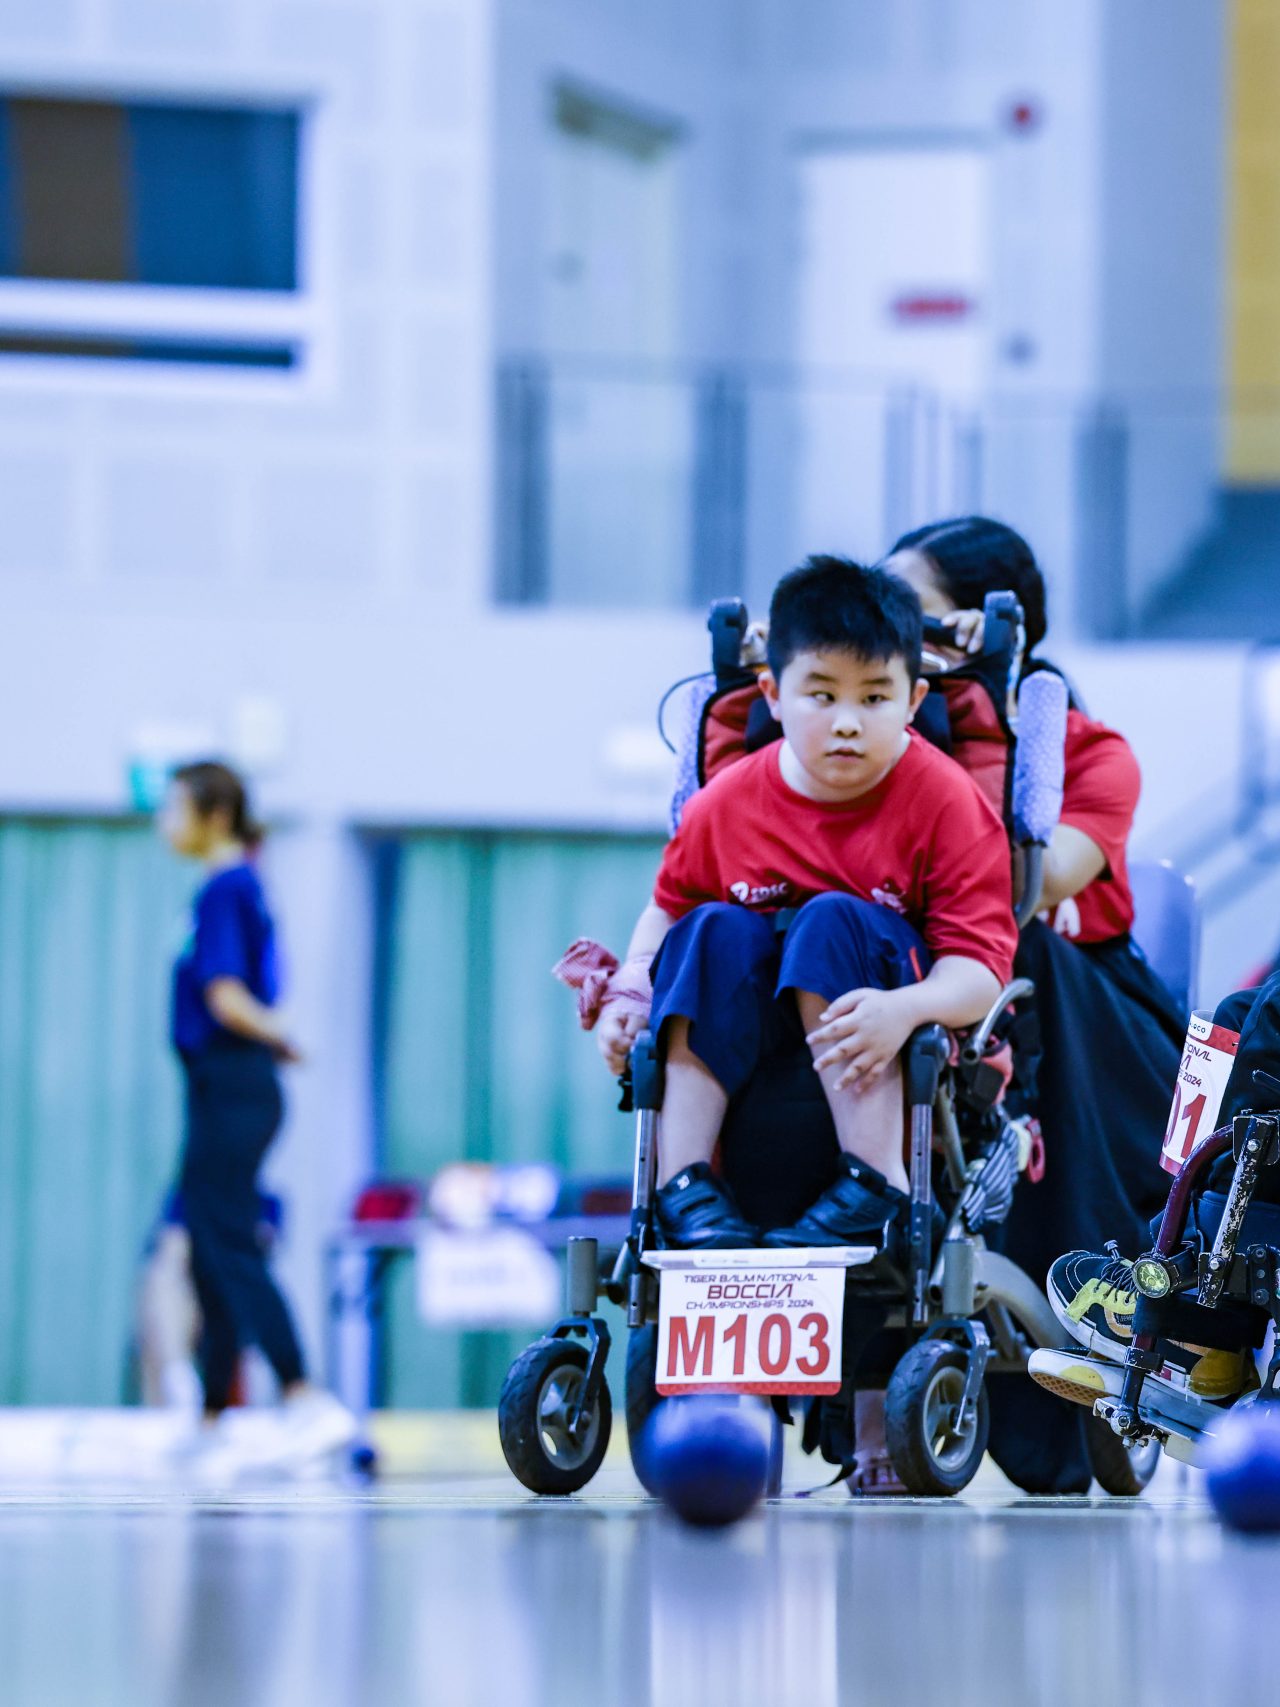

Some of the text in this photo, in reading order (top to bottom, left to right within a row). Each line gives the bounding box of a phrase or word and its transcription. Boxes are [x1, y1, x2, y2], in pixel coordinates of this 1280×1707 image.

[1183, 1071, 1202, 1087] 2024
[684, 1273, 818, 1283] TIGER BALM NATIONAL
[708, 1284, 793, 1299] BOCCIA
[686, 1299, 814, 1309] CHAMPIONSHIPS 2024
[667, 1312, 830, 1377] M103
